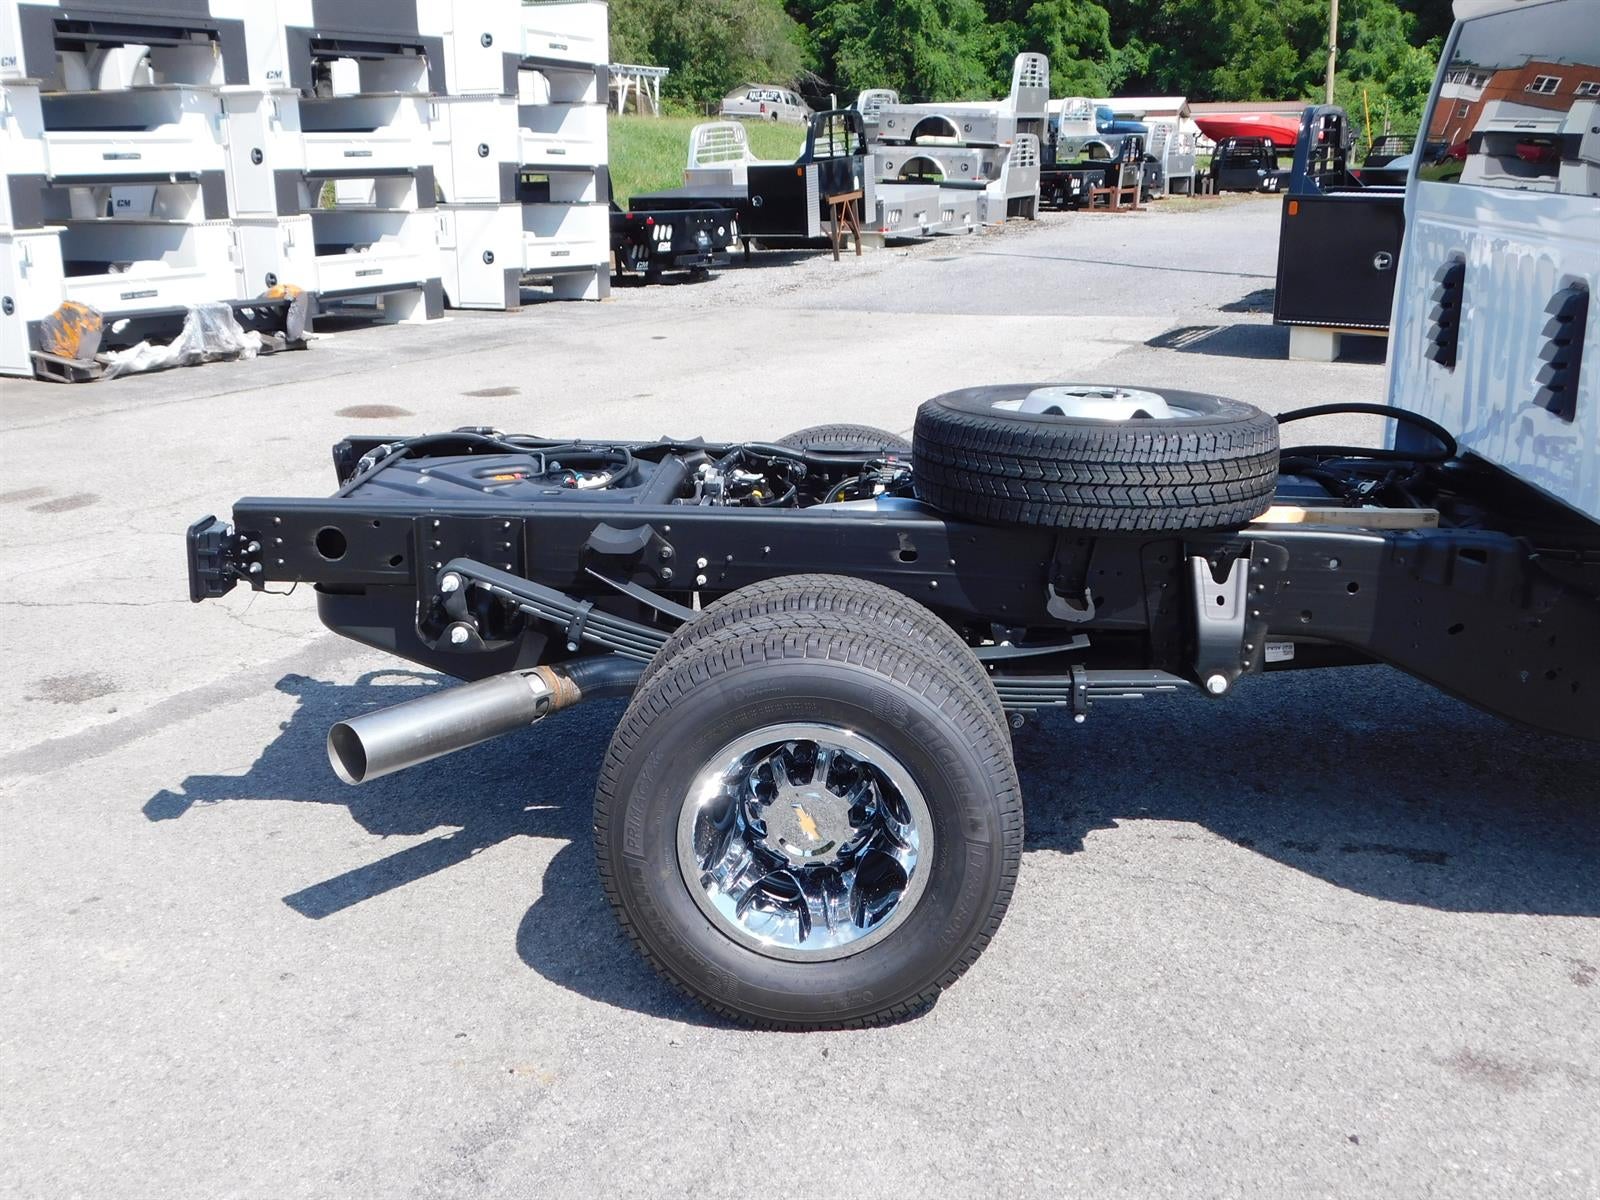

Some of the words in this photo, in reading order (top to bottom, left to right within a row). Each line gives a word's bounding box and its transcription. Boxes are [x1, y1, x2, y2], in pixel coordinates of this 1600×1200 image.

[1, 56, 17, 67] CM
[266, 70, 283, 80] CM
[627, 765, 656, 849] PRIMACY
